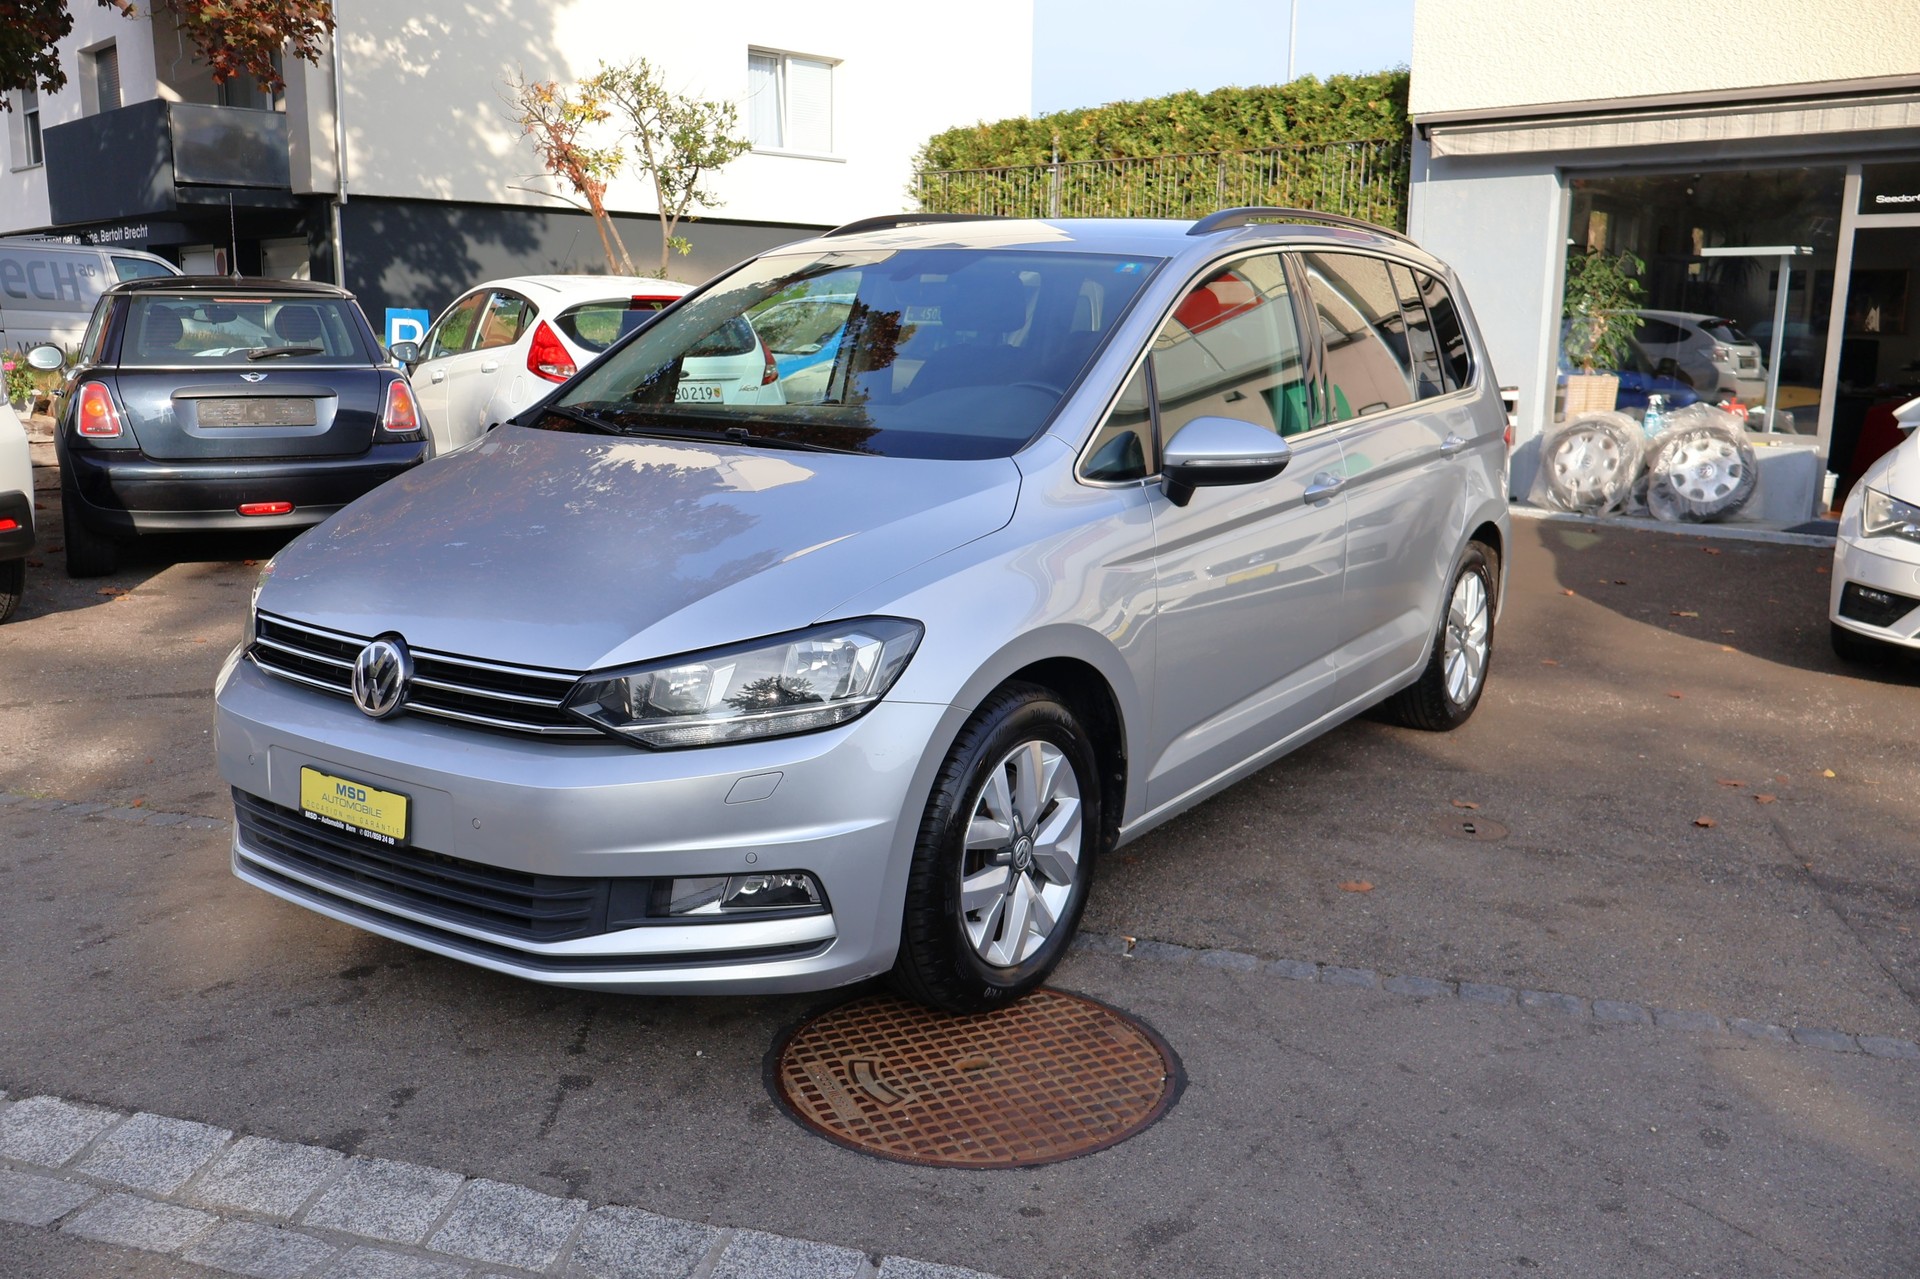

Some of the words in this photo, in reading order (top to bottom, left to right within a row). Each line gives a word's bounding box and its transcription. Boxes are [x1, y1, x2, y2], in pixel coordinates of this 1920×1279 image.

[100, 226, 123, 243] Bertolt
[124, 224, 148, 240] Brecht
[336, 783, 366, 802] MSD
[321, 793, 382, 818] AUTOMOBILE
